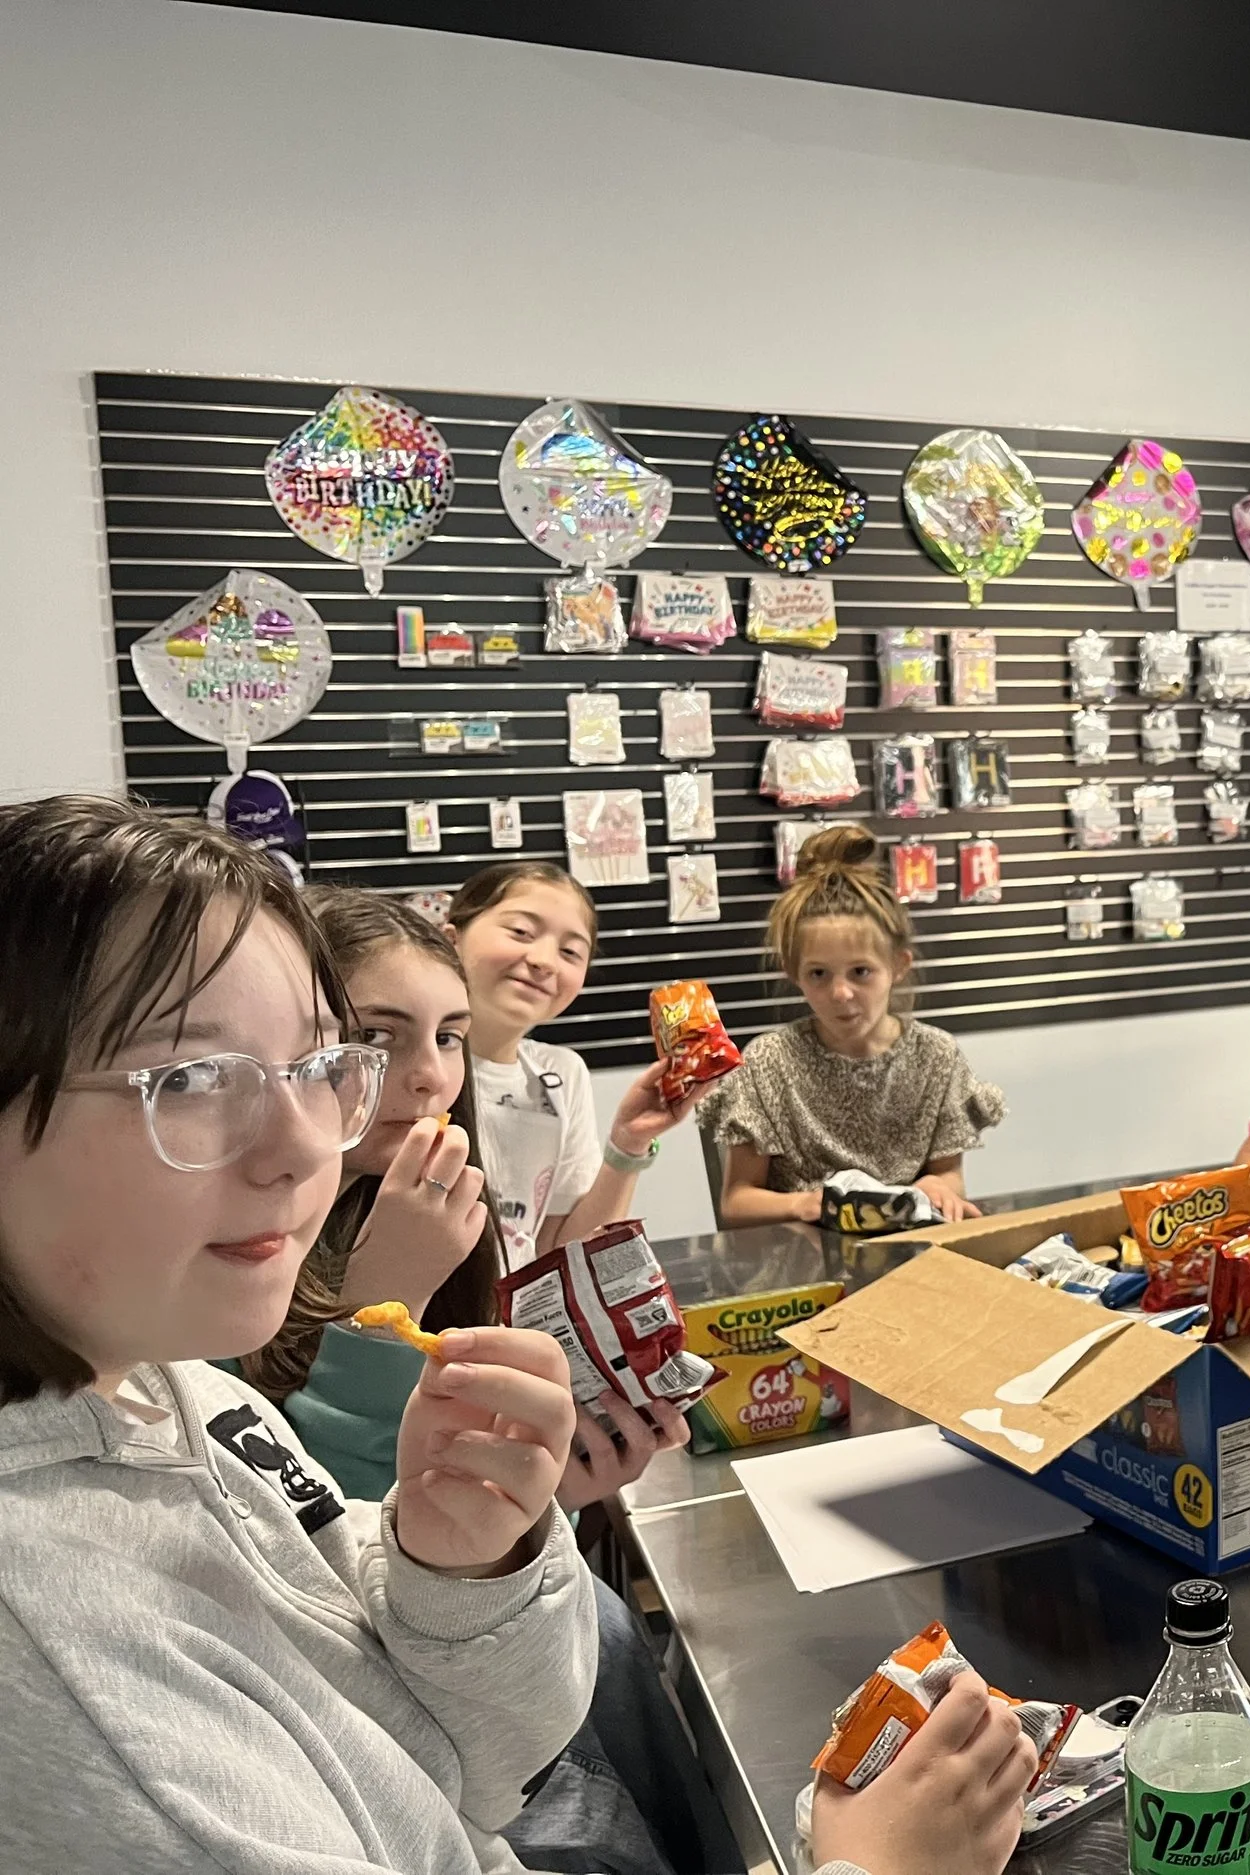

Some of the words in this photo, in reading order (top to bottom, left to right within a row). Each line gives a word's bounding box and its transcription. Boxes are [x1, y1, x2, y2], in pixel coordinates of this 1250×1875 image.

[655, 604, 714, 619] BIRTHDAY
[665, 593, 705, 605] HAPPY
[970, 752, 997, 786] H
[1149, 1189, 1228, 1246] Cheetos
[719, 1298, 813, 1330] Crayola
[752, 1370, 790, 1400] 64
[739, 1398, 805, 1424] CRAYON
[752, 1416, 795, 1433] COLORS
[1102, 1446, 1169, 1496] classic
[1182, 1473, 1203, 1507] 42
[1166, 1852, 1201, 1867] ZERO
[1202, 1847, 1246, 1867] SUGAR
